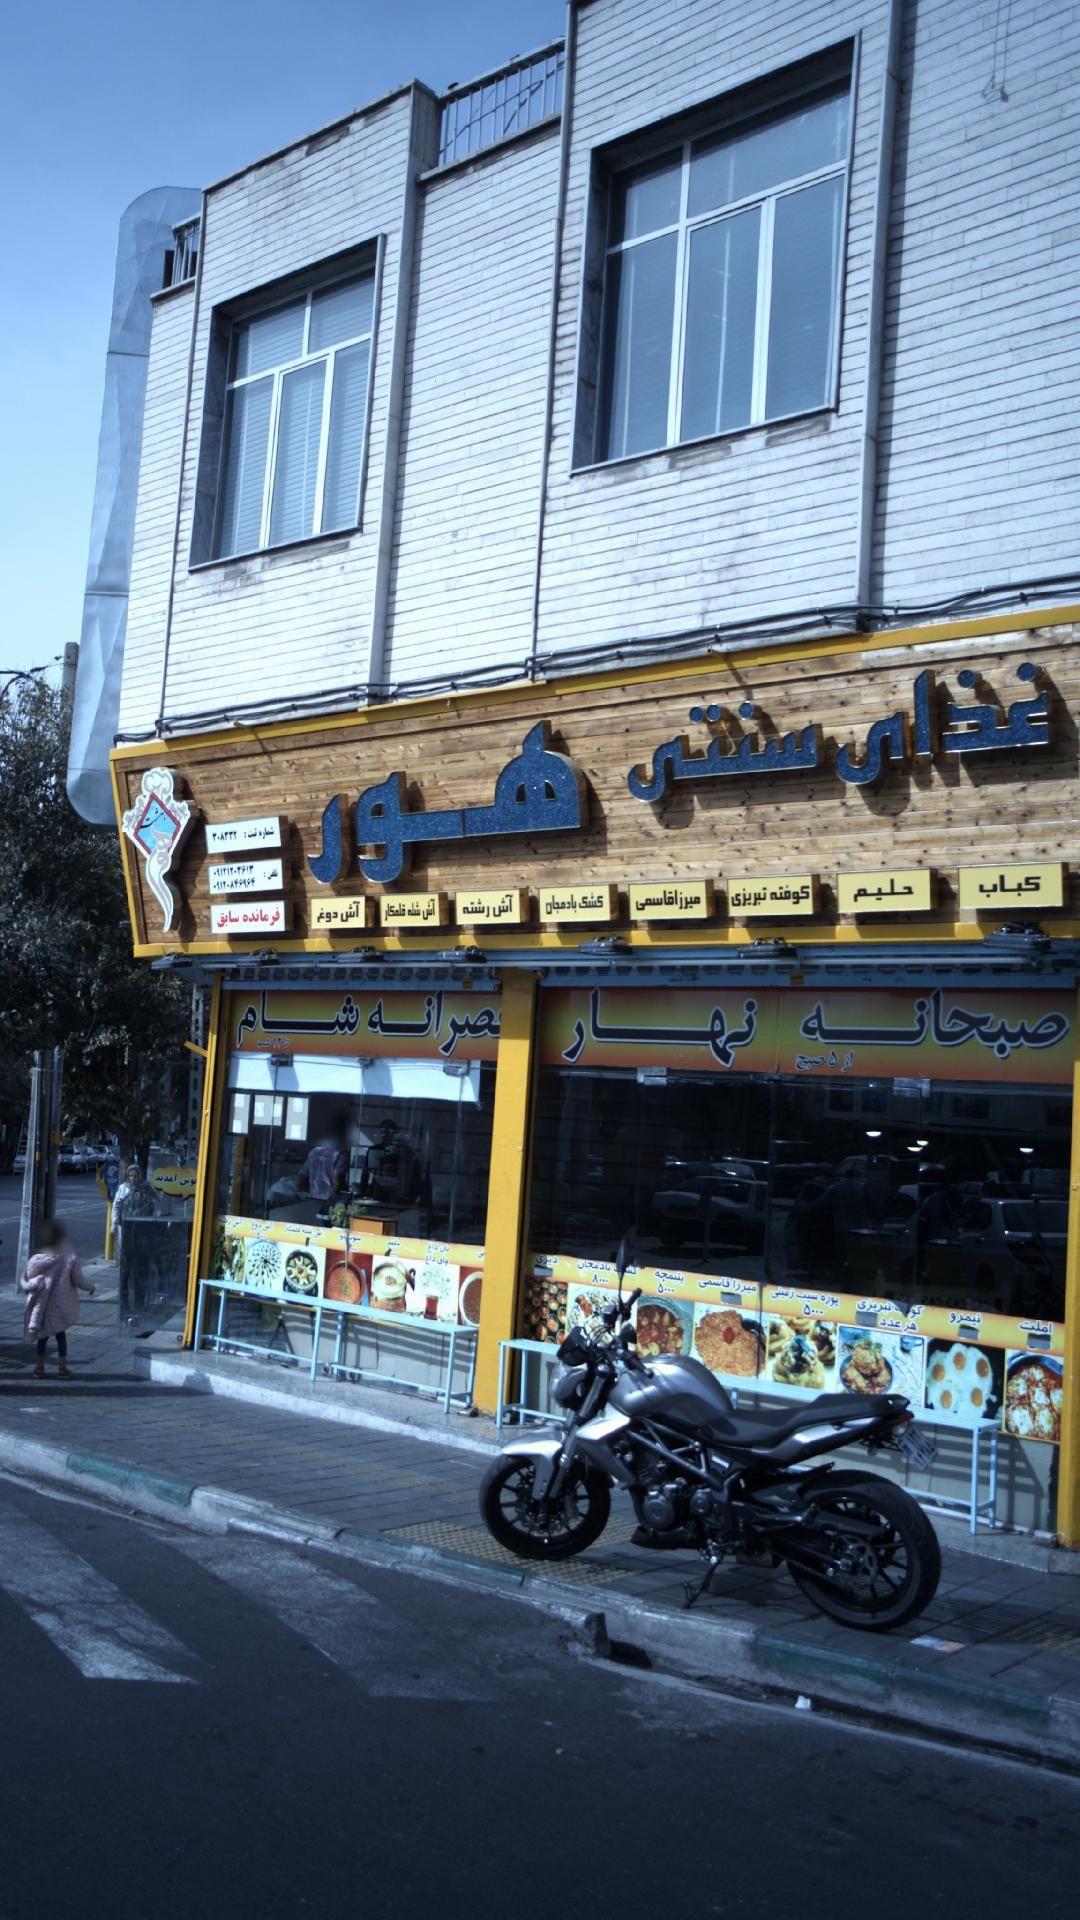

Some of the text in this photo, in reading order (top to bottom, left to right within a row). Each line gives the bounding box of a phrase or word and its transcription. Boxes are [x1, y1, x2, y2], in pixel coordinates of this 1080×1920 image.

[836, 662, 1050, 785] غذای
[627, 701, 822, 802] سنتی
[259, 826, 274, 839] شماره
[731, 885, 810, 907] کوفته تبریزی
[853, 878, 913, 903] حلیم
[978, 874, 1041, 898] کباب
[317, 900, 360, 923] آش دوغ
[384, 899, 435, 921] آش شله قلمکار
[463, 894, 513, 917] آش رشته
[546, 892, 604, 915] کشک بادمجان
[216, 905, 281, 928] فرمانده سابق
[237, 990, 501, 1057] صرانه شام
[562, 988, 1070, 1067] صبحانه نهار
[795, 1050, 854, 1072] از ۵ صبح
[155, 1172, 197, 1187] وش آمدید
[577, 1257, 611, 1272] بادمجان
[657, 1282, 675, 1293] ۵۰۰۰
[698, 1277, 757, 1293] میرزا قاسمی
[771, 1287, 839, 1307] پوره سیب زمینی
[857, 1299, 892, 1313] تبریزی
[803, 1303, 824, 1315] ۵۰۰۰
[950, 1311, 981, 1324] نیمرو
[880, 1317, 917, 1332] هر عدد
[1019, 1320, 1053, 1333] املت
